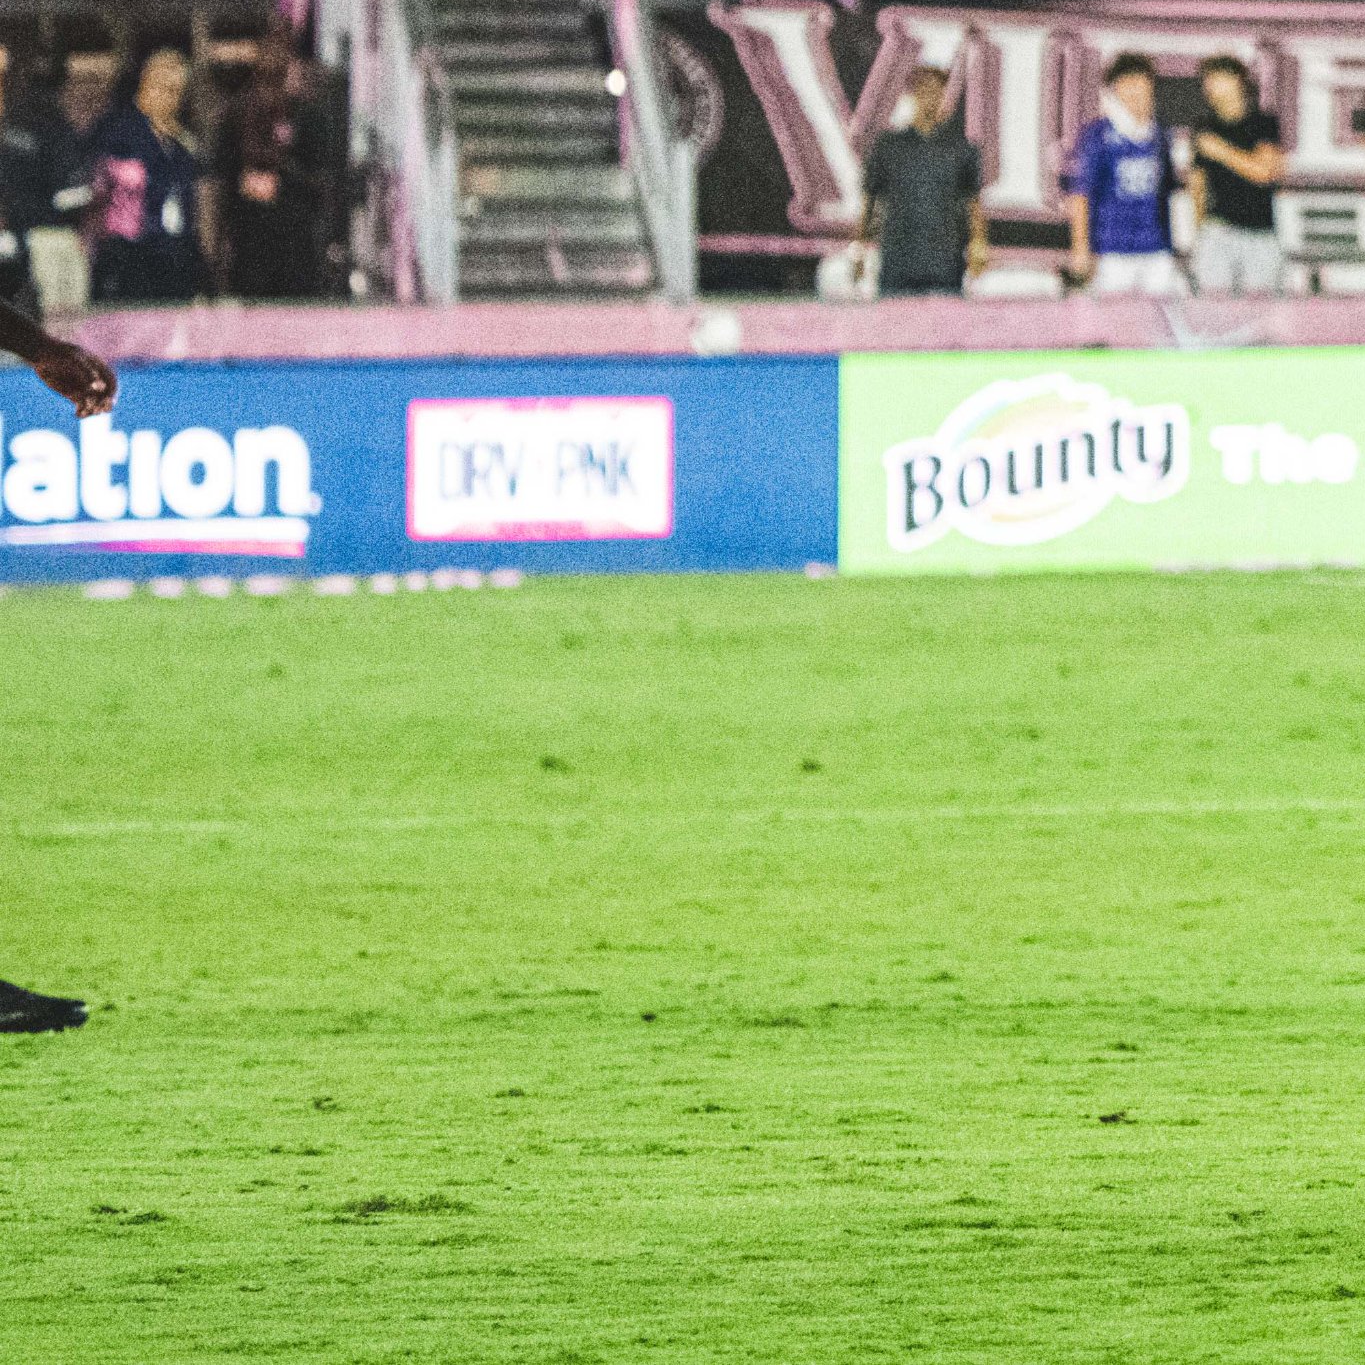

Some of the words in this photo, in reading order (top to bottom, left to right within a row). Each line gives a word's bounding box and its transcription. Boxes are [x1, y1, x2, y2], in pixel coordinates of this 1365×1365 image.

[0, 411, 312, 522] ation
[438, 438, 527, 500] DRV
[556, 438, 641, 498] PNK
[903, 419, 1174, 533] Bounty
[1210, 422, 1359, 484] The
